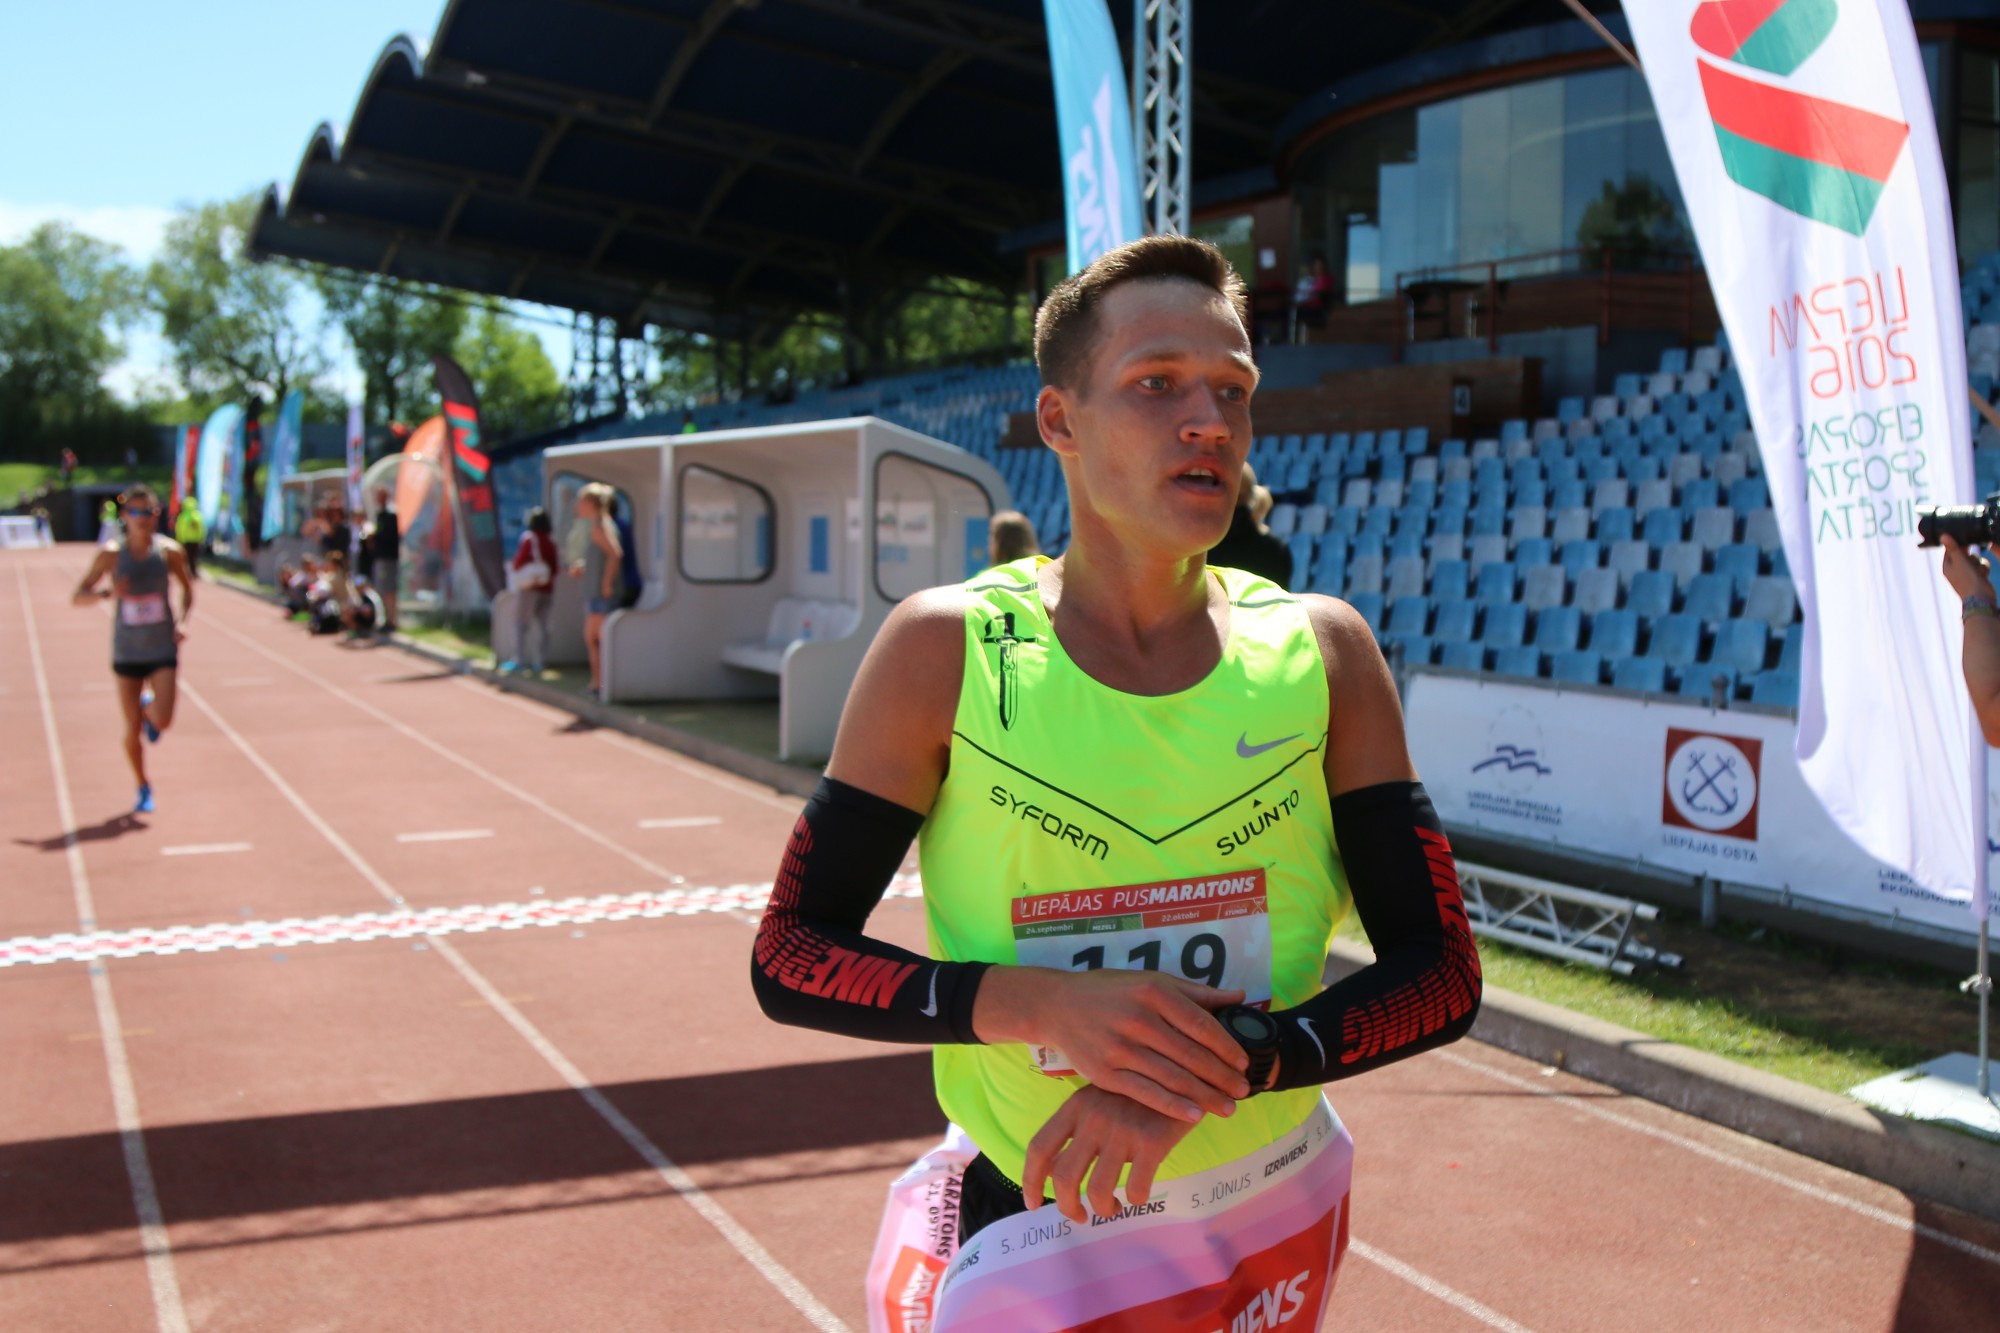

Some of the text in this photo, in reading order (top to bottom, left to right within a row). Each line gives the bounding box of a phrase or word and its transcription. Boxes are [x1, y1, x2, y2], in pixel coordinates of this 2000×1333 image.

[989, 785, 1110, 861] SYFORM
[1216, 789, 1299, 856] SUUNTO
[1021, 876, 1257, 918] LIEPĀJAS PUSMARATONS
[800, 944, 921, 1010] NIKE
[1001, 1238, 1015, 1254] 5.
[1020, 1219, 1072, 1249] JŪNIJS
[1191, 1193, 1205, 1209] 5.
[1209, 1172, 1252, 1203] JŪNIJS
[1264, 1140, 1309, 1178] IZRAVIENS
